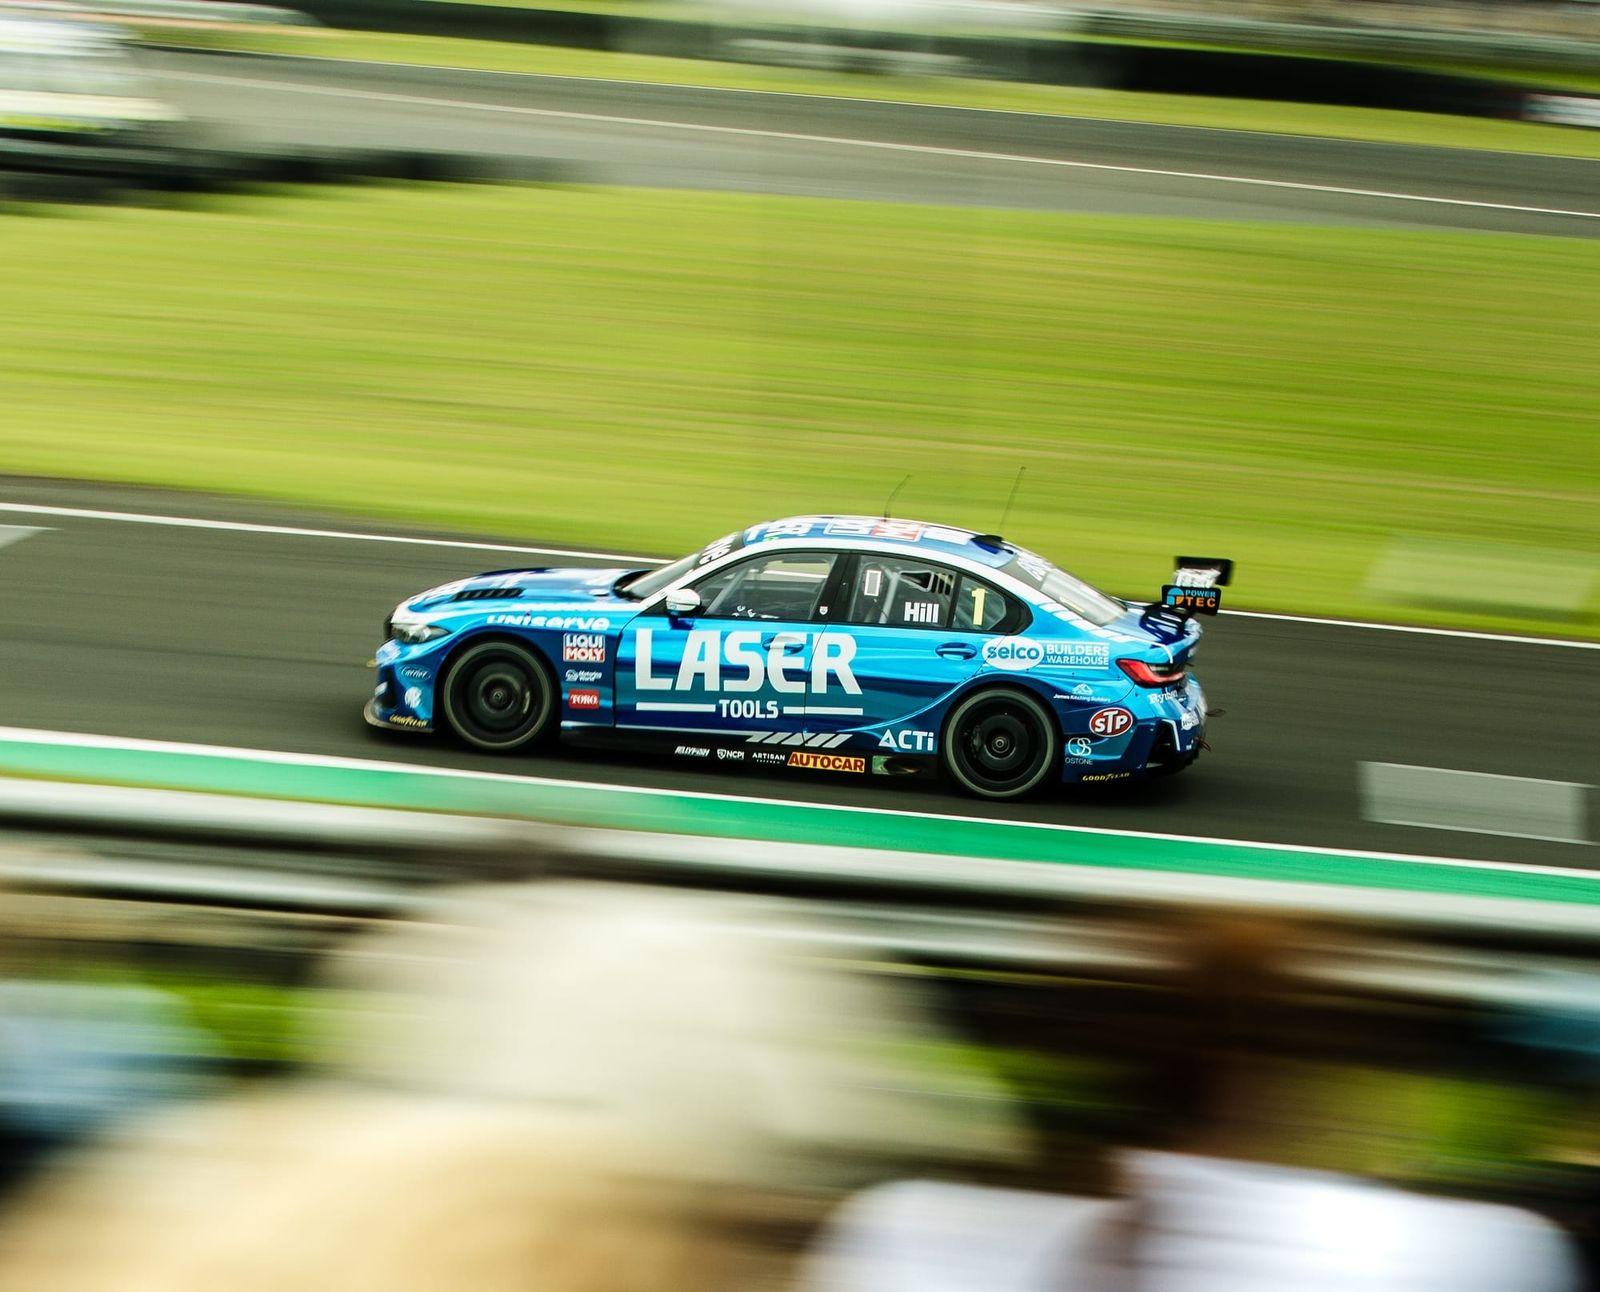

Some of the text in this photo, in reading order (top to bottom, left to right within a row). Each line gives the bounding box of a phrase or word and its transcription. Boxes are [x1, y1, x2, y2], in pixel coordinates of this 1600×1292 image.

[1185, 590, 1216, 598] POWER
[903, 601, 940, 623] Hill
[971, 587, 986, 626] 1
[565, 634, 605, 648] LIQUI
[564, 648, 604, 661] MOLY
[987, 643, 1040, 660] selco
[1045, 643, 1110, 656] BUILDERS
[635, 628, 863, 695] LASER
[1046, 655, 1110, 666] WAREHOUSE
[718, 700, 780, 719] TOOLS
[1094, 710, 1128, 734] STP
[752, 752, 786, 761] ARTISAN
[787, 753, 865, 772] AUTOCAR
[1064, 757, 1093, 766] OSTONE
[1082, 772, 1130, 782] GOODYEAR
